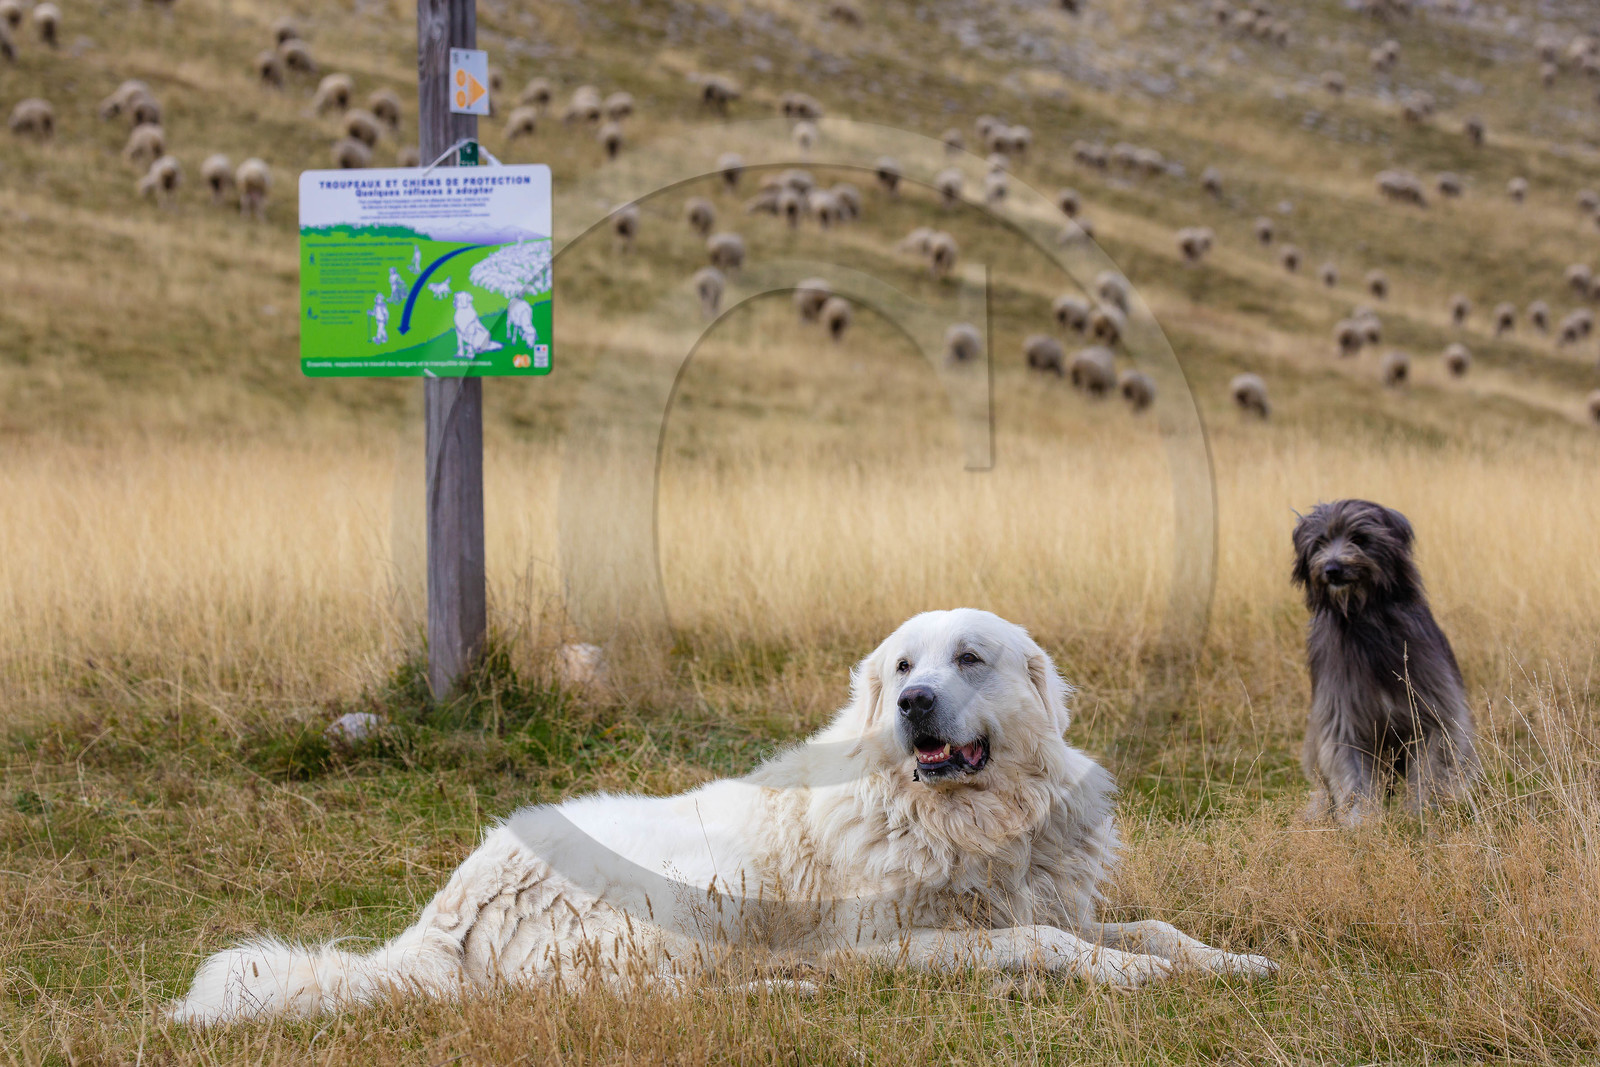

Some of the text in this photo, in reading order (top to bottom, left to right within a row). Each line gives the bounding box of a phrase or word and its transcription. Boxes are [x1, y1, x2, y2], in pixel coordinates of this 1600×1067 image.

[319, 176, 531, 189] TROUPEAUX ET CHIENS DE PROTECTION
[355, 189, 399, 197] Quelques
[456, 186, 493, 195] adopter
